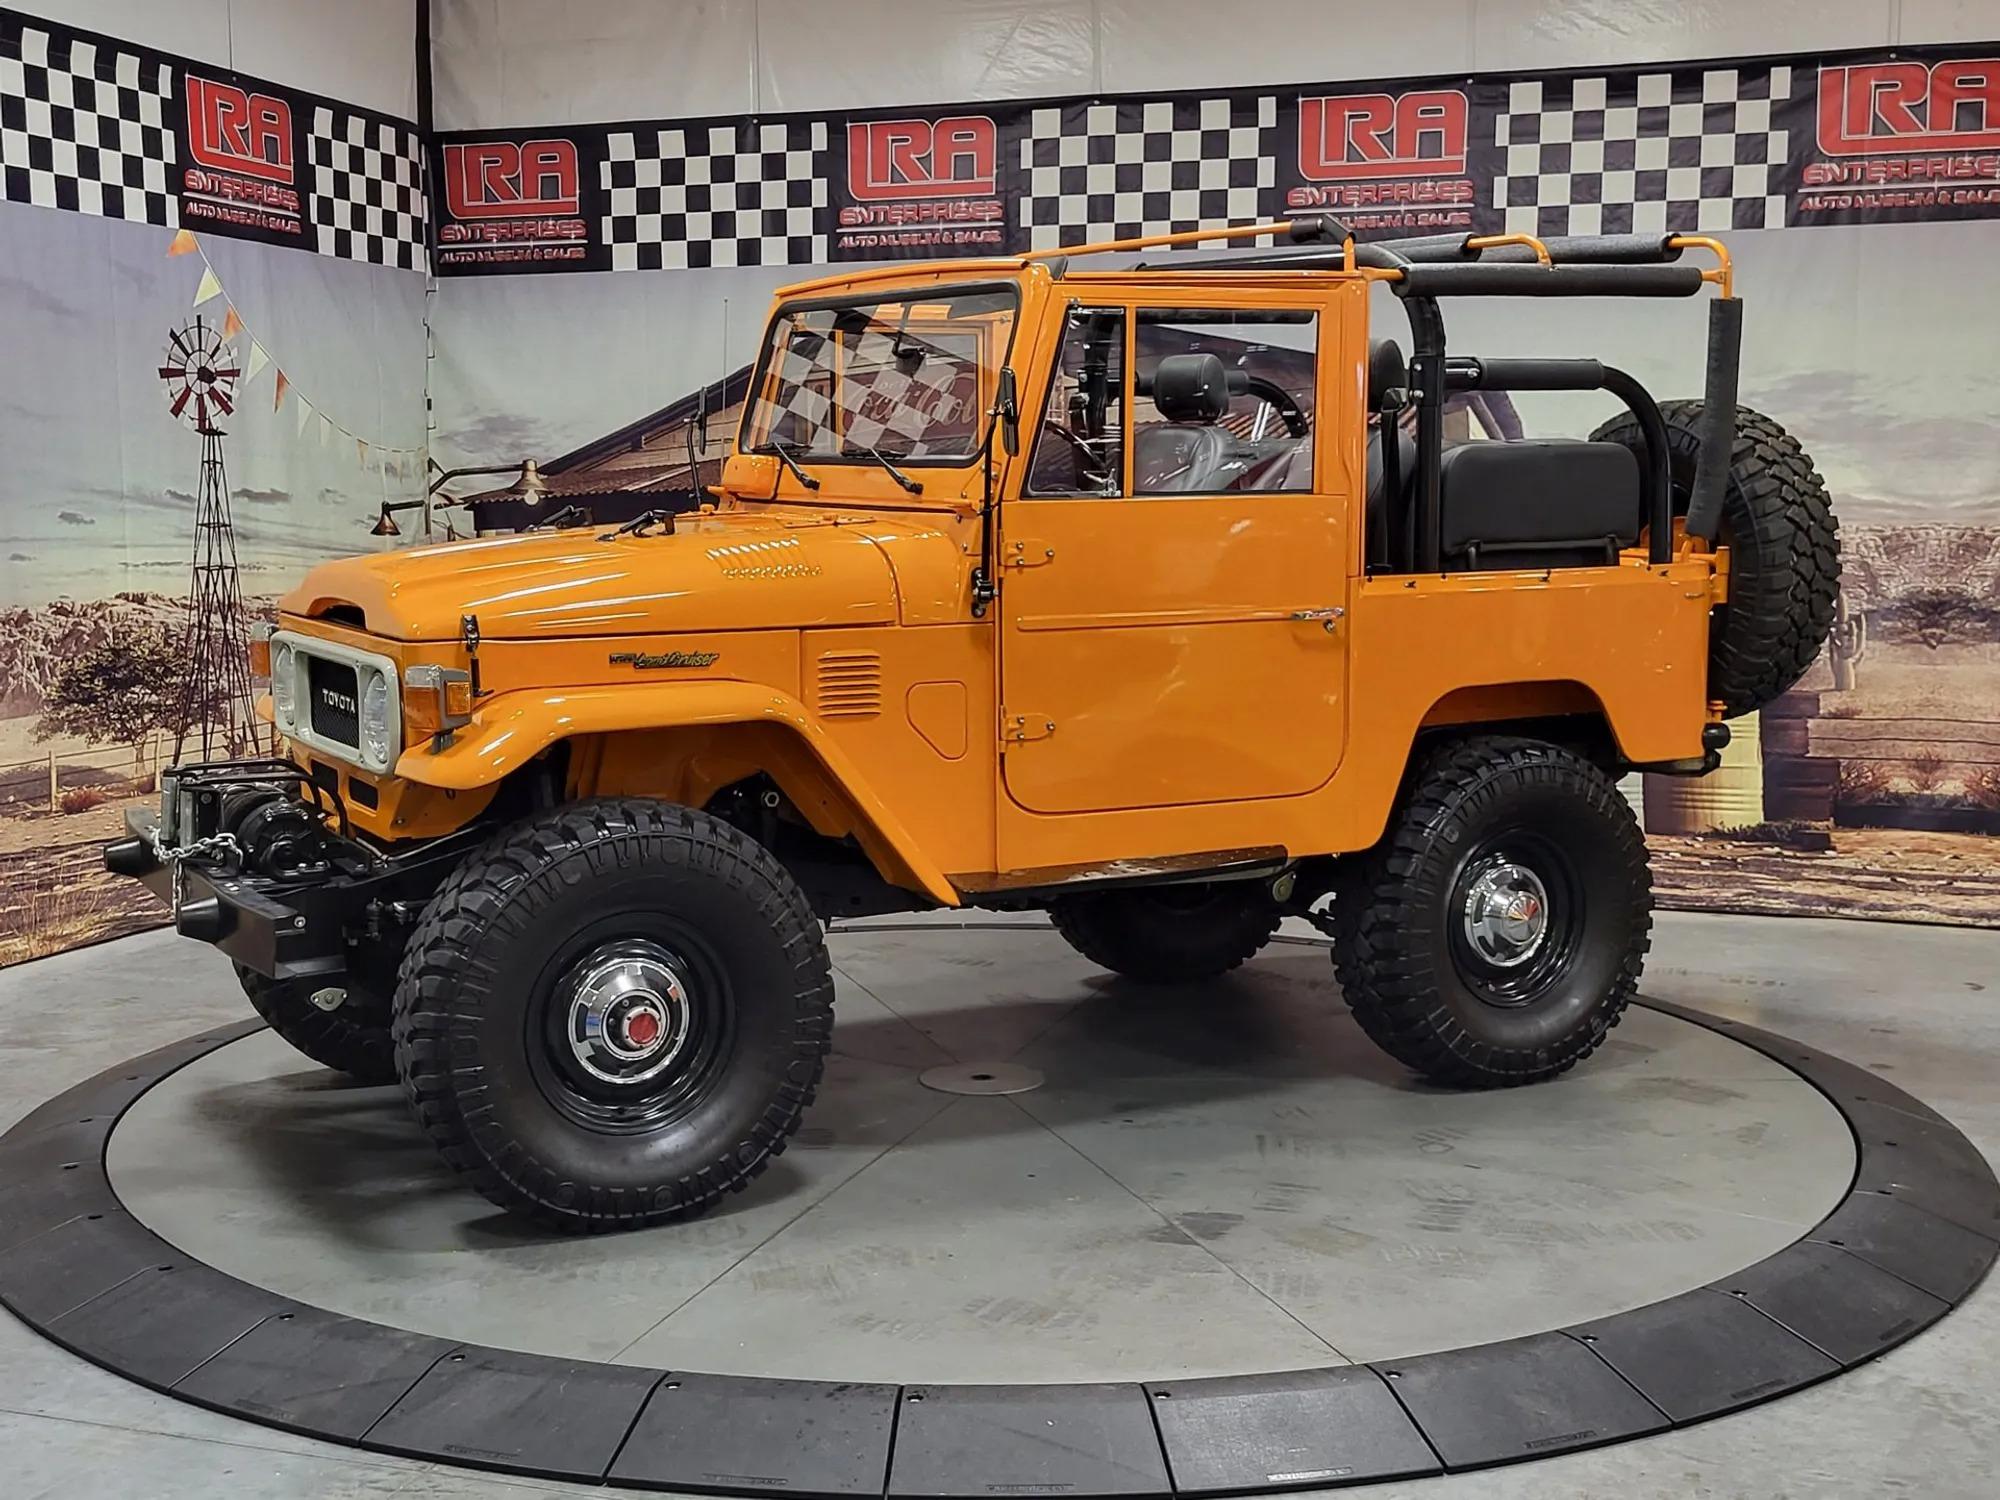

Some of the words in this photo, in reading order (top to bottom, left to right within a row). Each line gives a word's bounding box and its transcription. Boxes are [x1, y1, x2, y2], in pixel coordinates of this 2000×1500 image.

[1817, 58, 2000, 157] LRA
[185, 74, 294, 185] LRA
[1297, 89, 1469, 182] LRA
[845, 115, 997, 201] LRA
[1803, 155, 2000, 184] ENTERPRISE
[184, 168, 300, 210] ENTERPRISES
[442, 138, 580, 220] LRA
[1287, 180, 1474, 207] ENTERPRISES
[1800, 196, 1852, 211] AUTO
[1953, 189, 2000, 205] SALE
[186, 201, 216, 218] AUTO
[839, 201, 1003, 226] ENTERPRISES
[440, 219, 586, 242] ENTERPRISES
[838, 235, 878, 248] AUTO
[440, 252, 476, 263] AUTO
[847, 372, 975, 428] Coca-Col
[322, 688, 355, 714] TOYOTA
